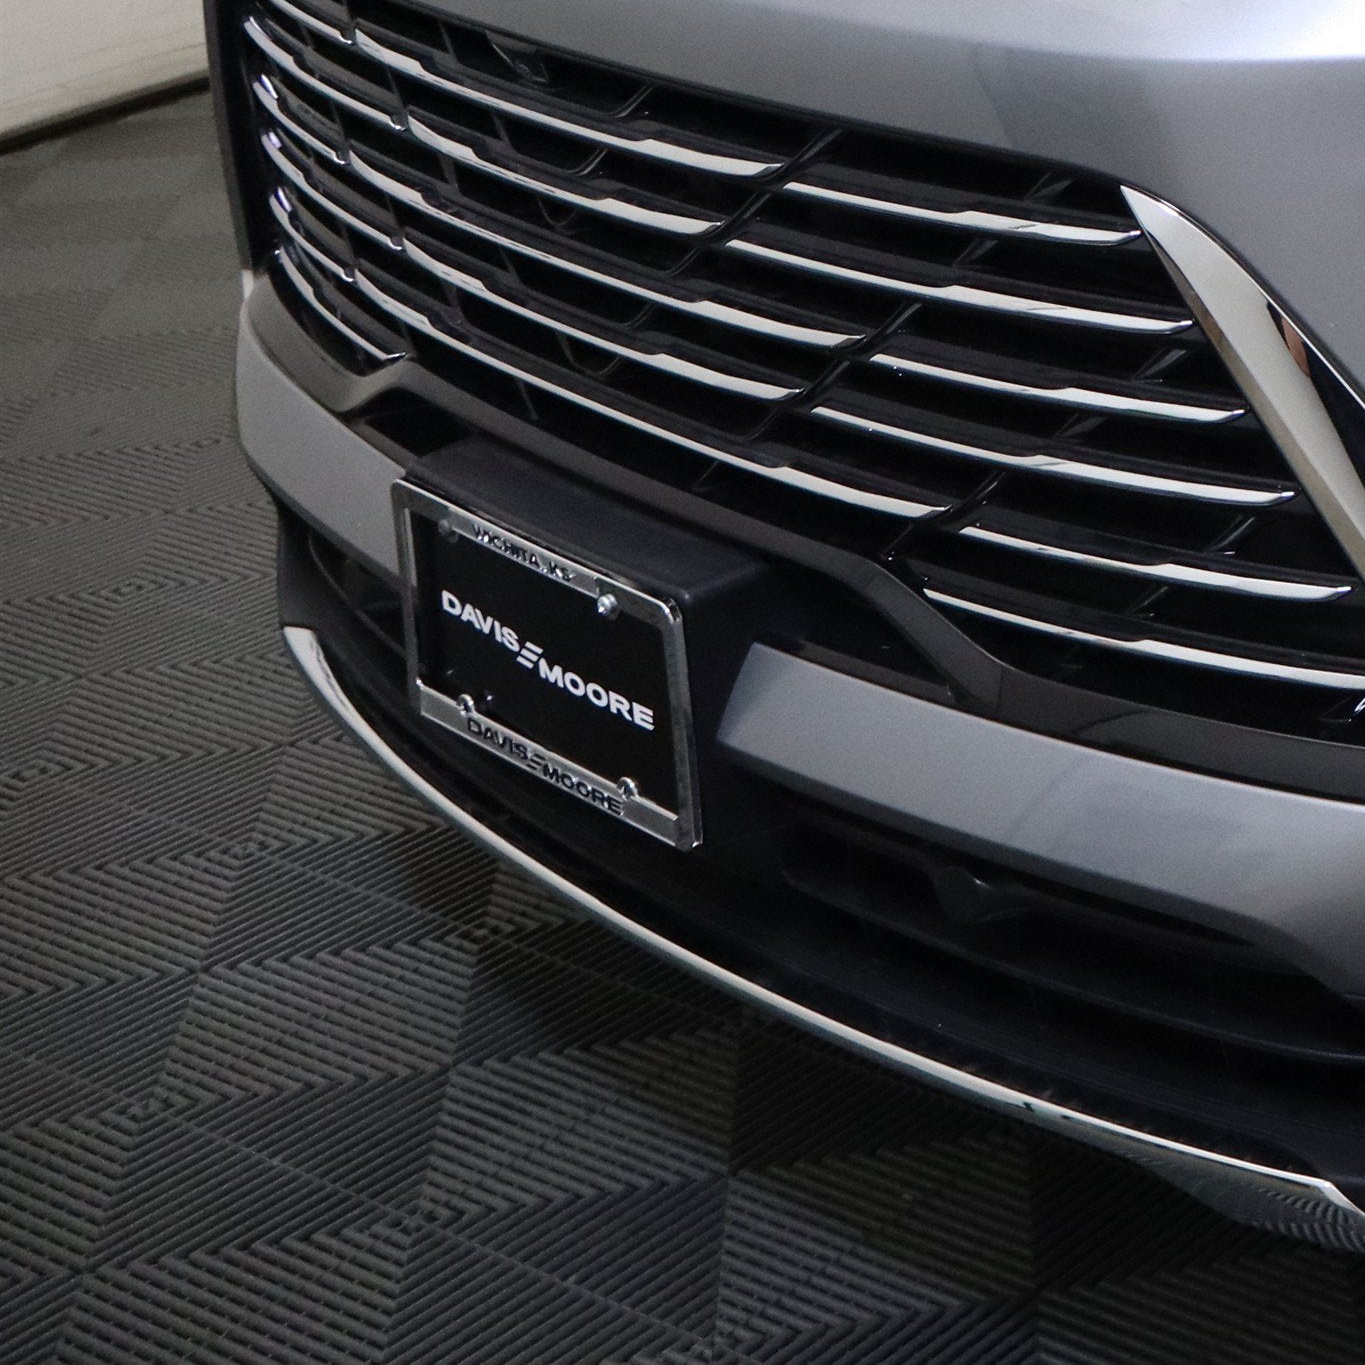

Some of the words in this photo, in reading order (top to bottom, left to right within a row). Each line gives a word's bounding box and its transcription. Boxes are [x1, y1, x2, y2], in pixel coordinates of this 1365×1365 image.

[440, 589, 521, 654] DAVIS
[538, 656, 656, 732] MOORE
[467, 717, 530, 761] DAVIS
[542, 763, 625, 817] MOORE
